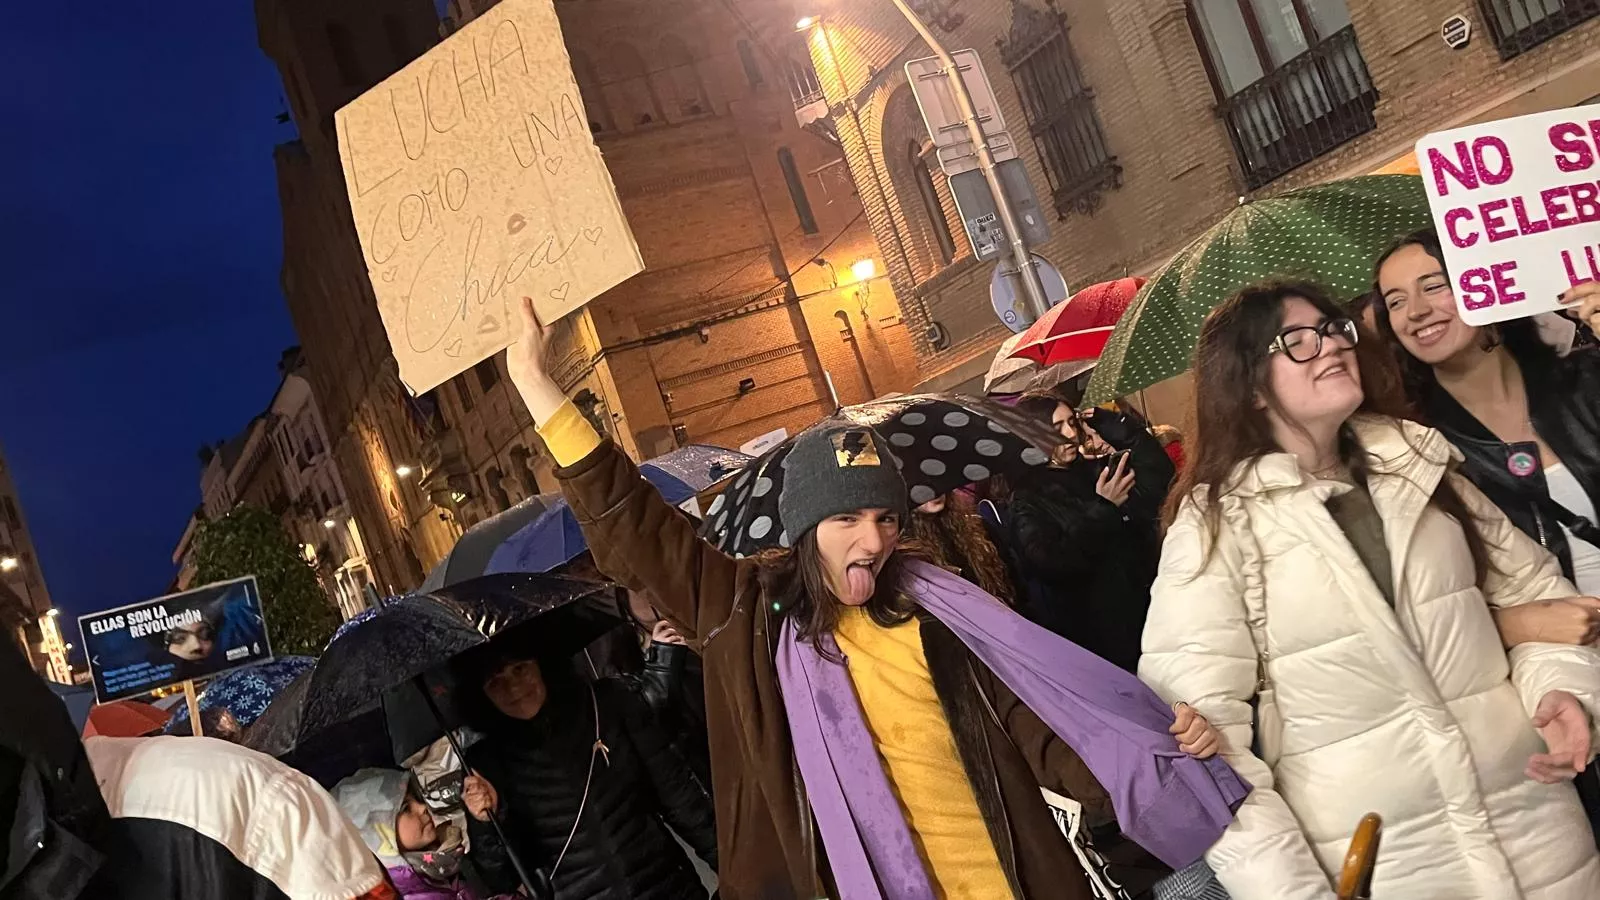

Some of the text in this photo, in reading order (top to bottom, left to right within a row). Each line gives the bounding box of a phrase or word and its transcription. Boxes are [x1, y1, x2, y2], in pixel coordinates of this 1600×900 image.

[344, 19, 529, 198] LUCHA
[370, 92, 584, 265] COMO UNA
[1427, 135, 1514, 197] NO
[1444, 180, 1600, 248] CELEB
[1459, 260, 1526, 311] SE
[90, 605, 168, 635] ELLAS SON LA
[130, 608, 202, 638] REVOLUCIÓN
